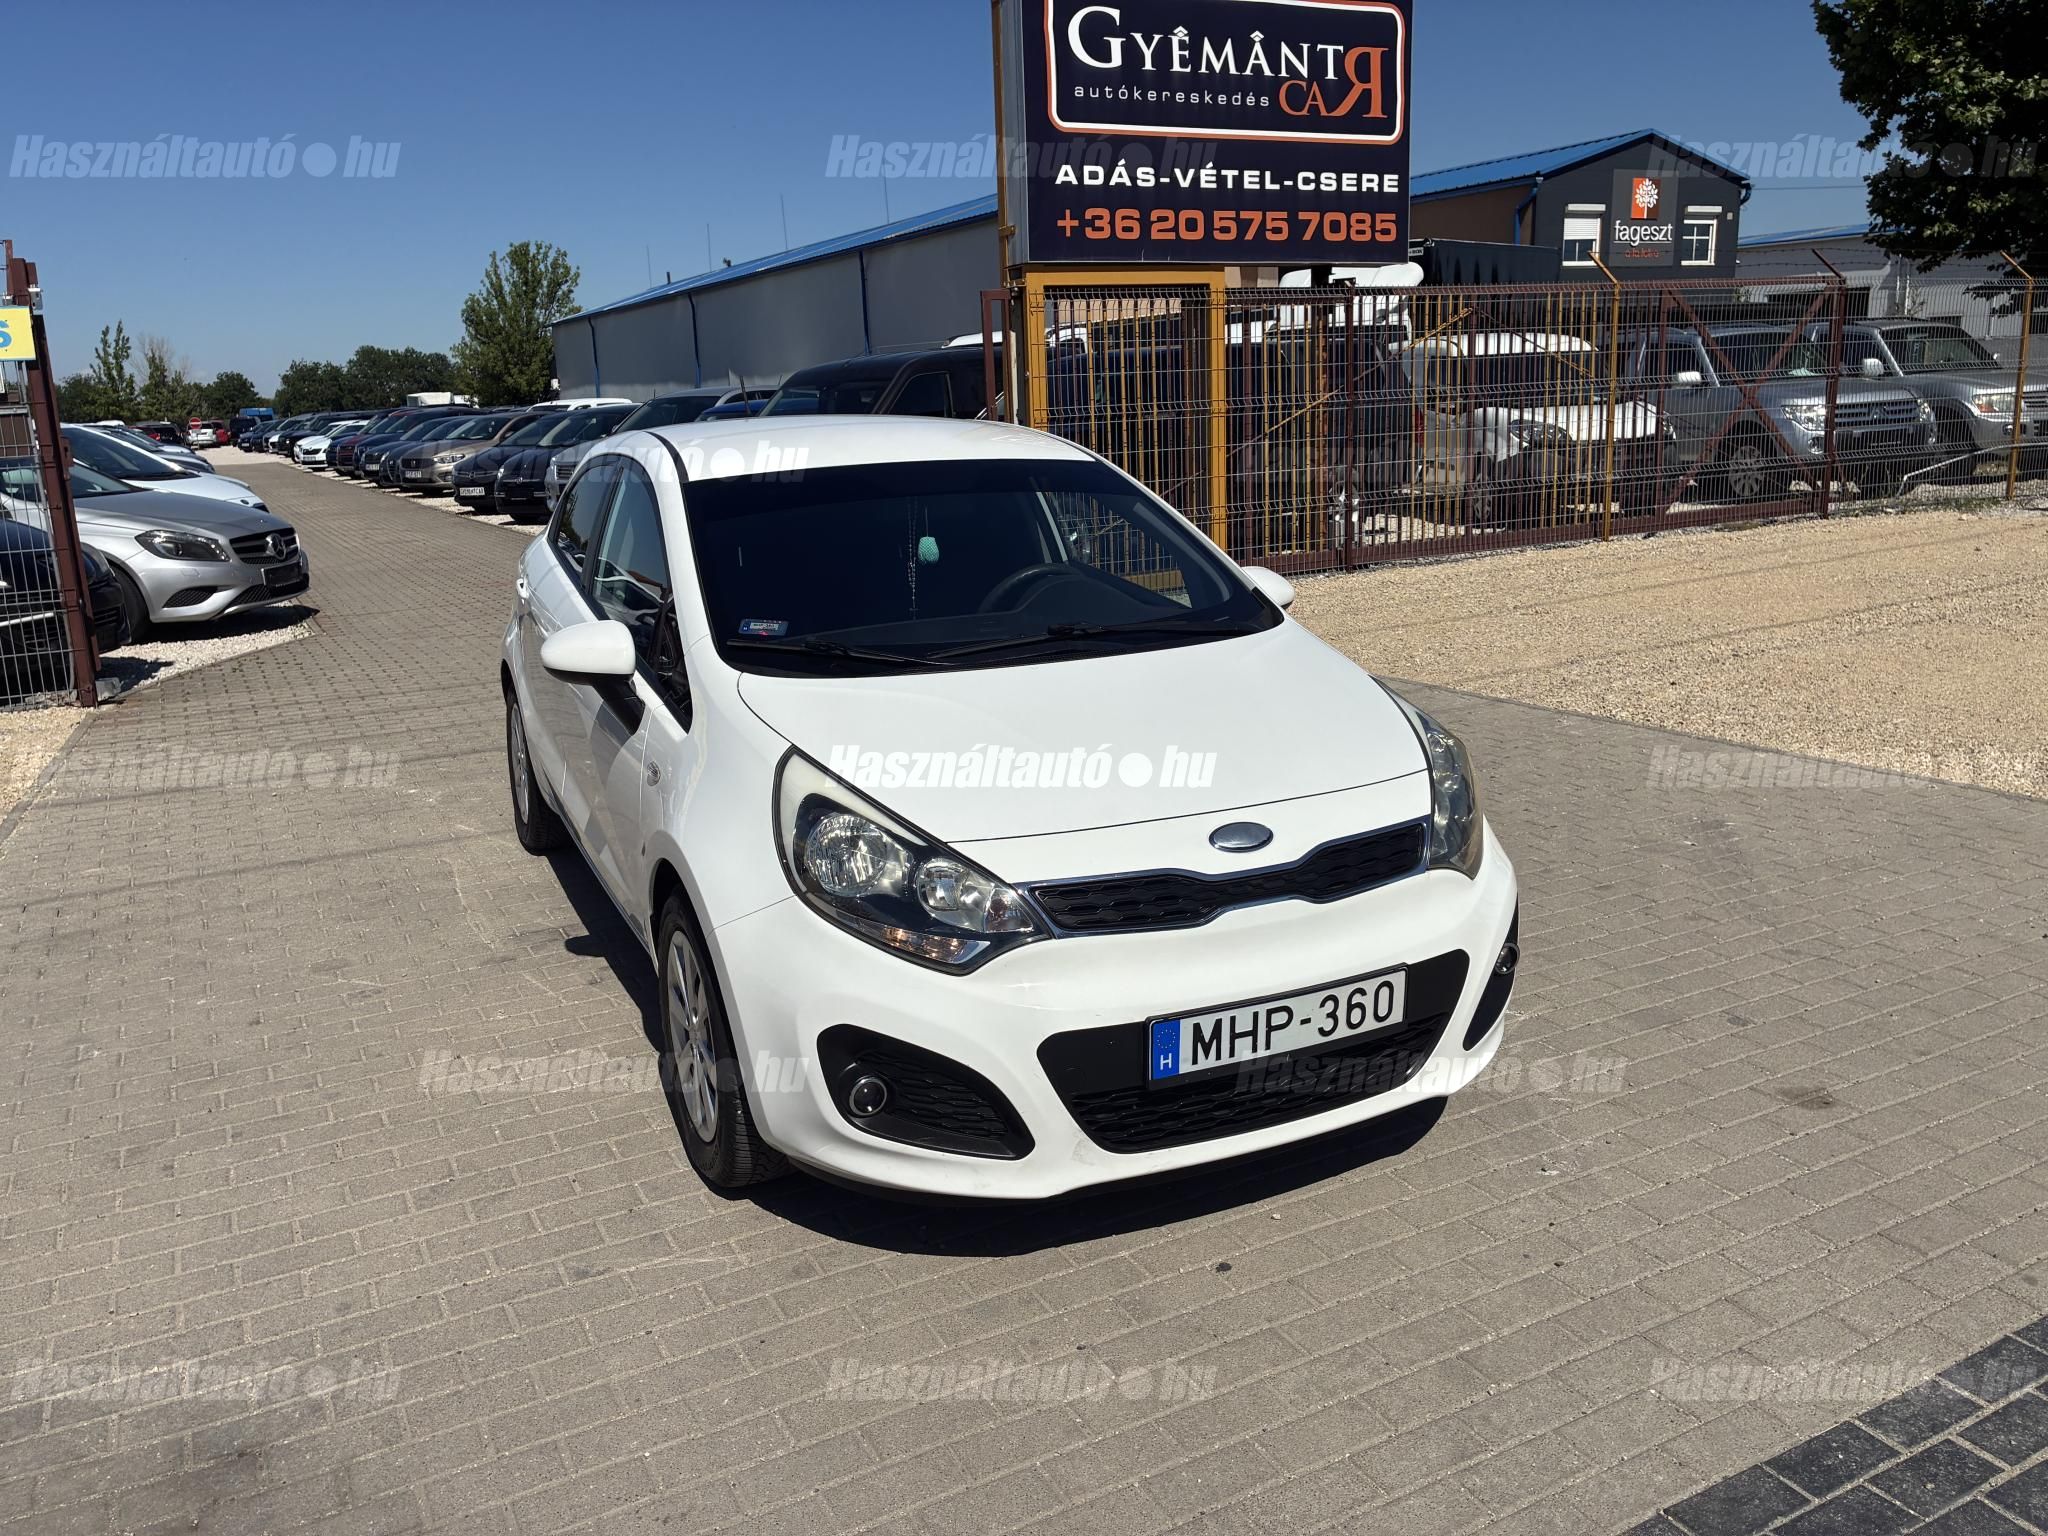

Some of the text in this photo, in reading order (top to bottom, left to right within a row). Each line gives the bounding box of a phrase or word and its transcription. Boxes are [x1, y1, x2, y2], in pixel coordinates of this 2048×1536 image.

[1074, 84, 1270, 107] autókereskedés
[1055, 159, 1399, 193] ADÁS-VÉTEL-CSERE
[1057, 208, 1397, 242] +36 20 575 7085
[1614, 220, 1673, 247] fageszt
[1159, 980, 1395, 1070] H MHP-360
